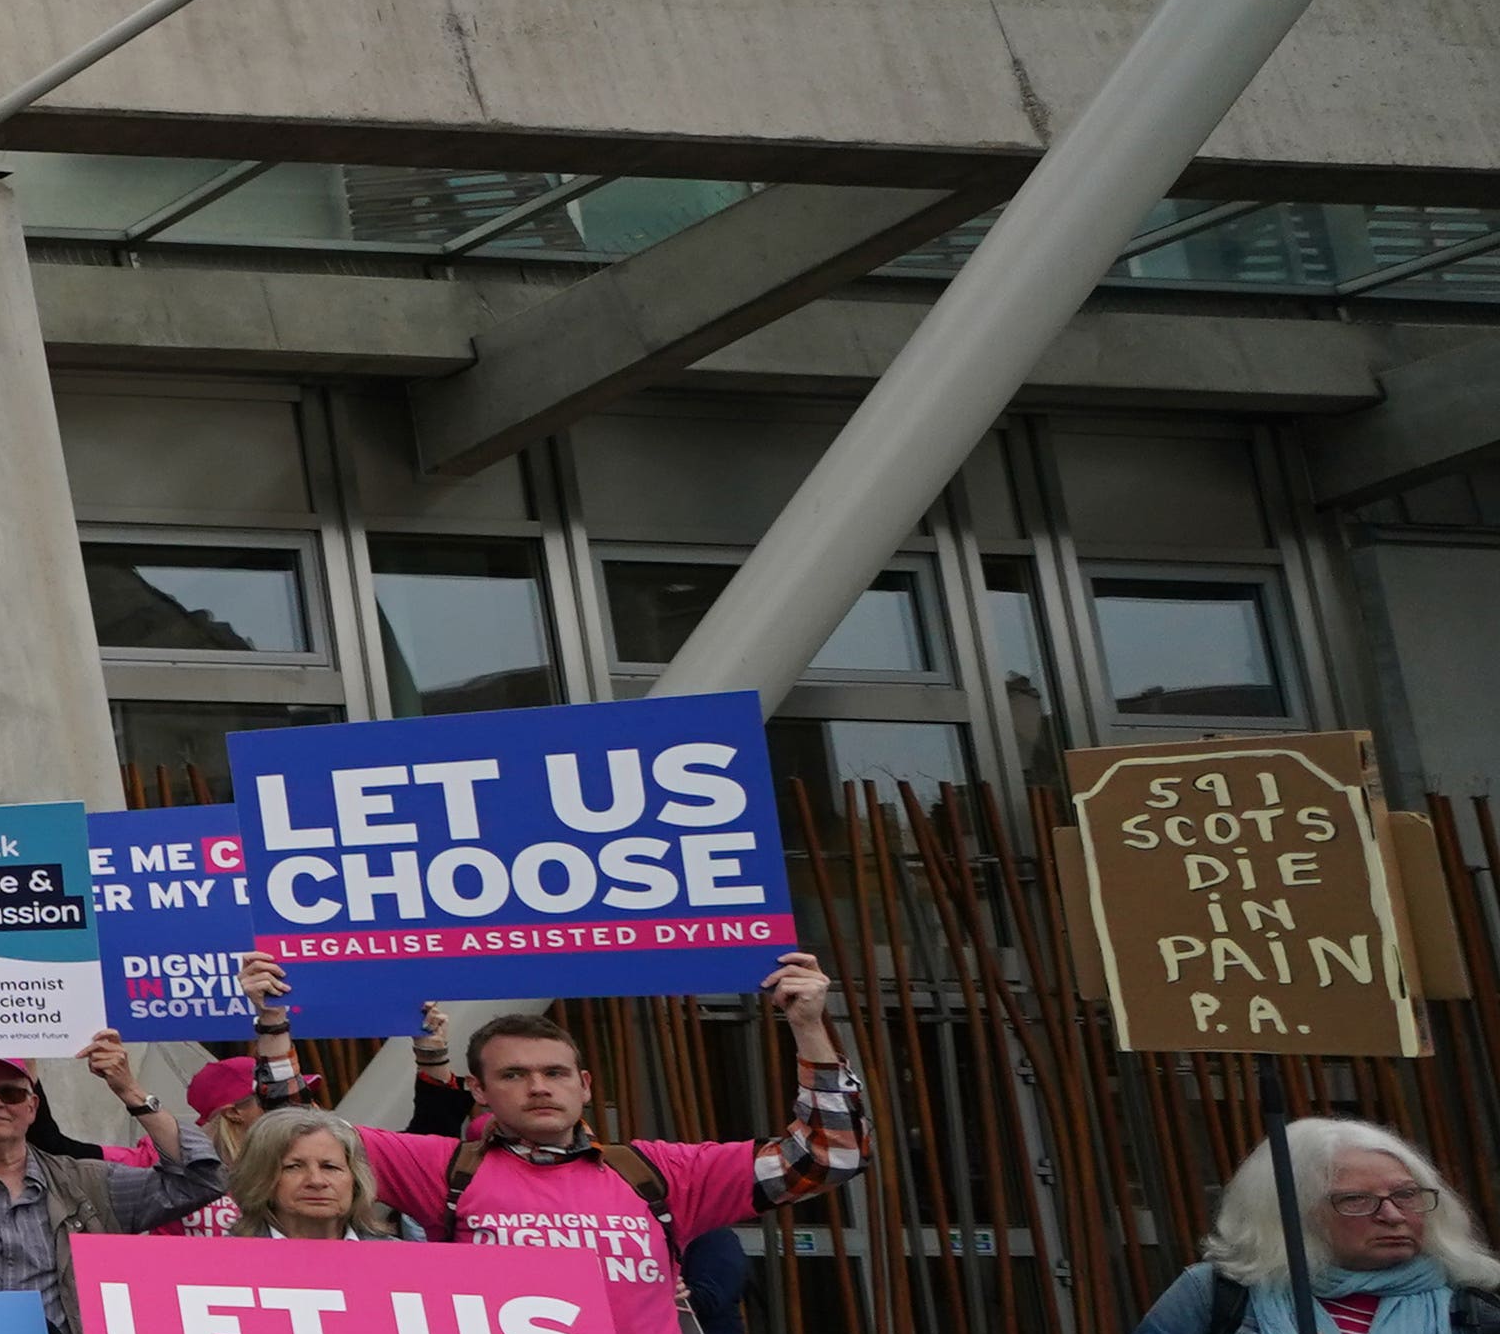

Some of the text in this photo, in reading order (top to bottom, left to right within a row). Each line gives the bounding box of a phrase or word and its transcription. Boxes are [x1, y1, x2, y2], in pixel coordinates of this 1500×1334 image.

[256, 742, 747, 851] LET US
[1145, 772, 1282, 809] 591
[1120, 806, 1338, 851] SCOTS
[30, 871, 53, 893] &
[266, 832, 766, 925] CHOOSE
[280, 921, 773, 958] LEGALISE ASSISTED DYING
[466, 1213, 650, 1233] CAMPAIGN FOR
